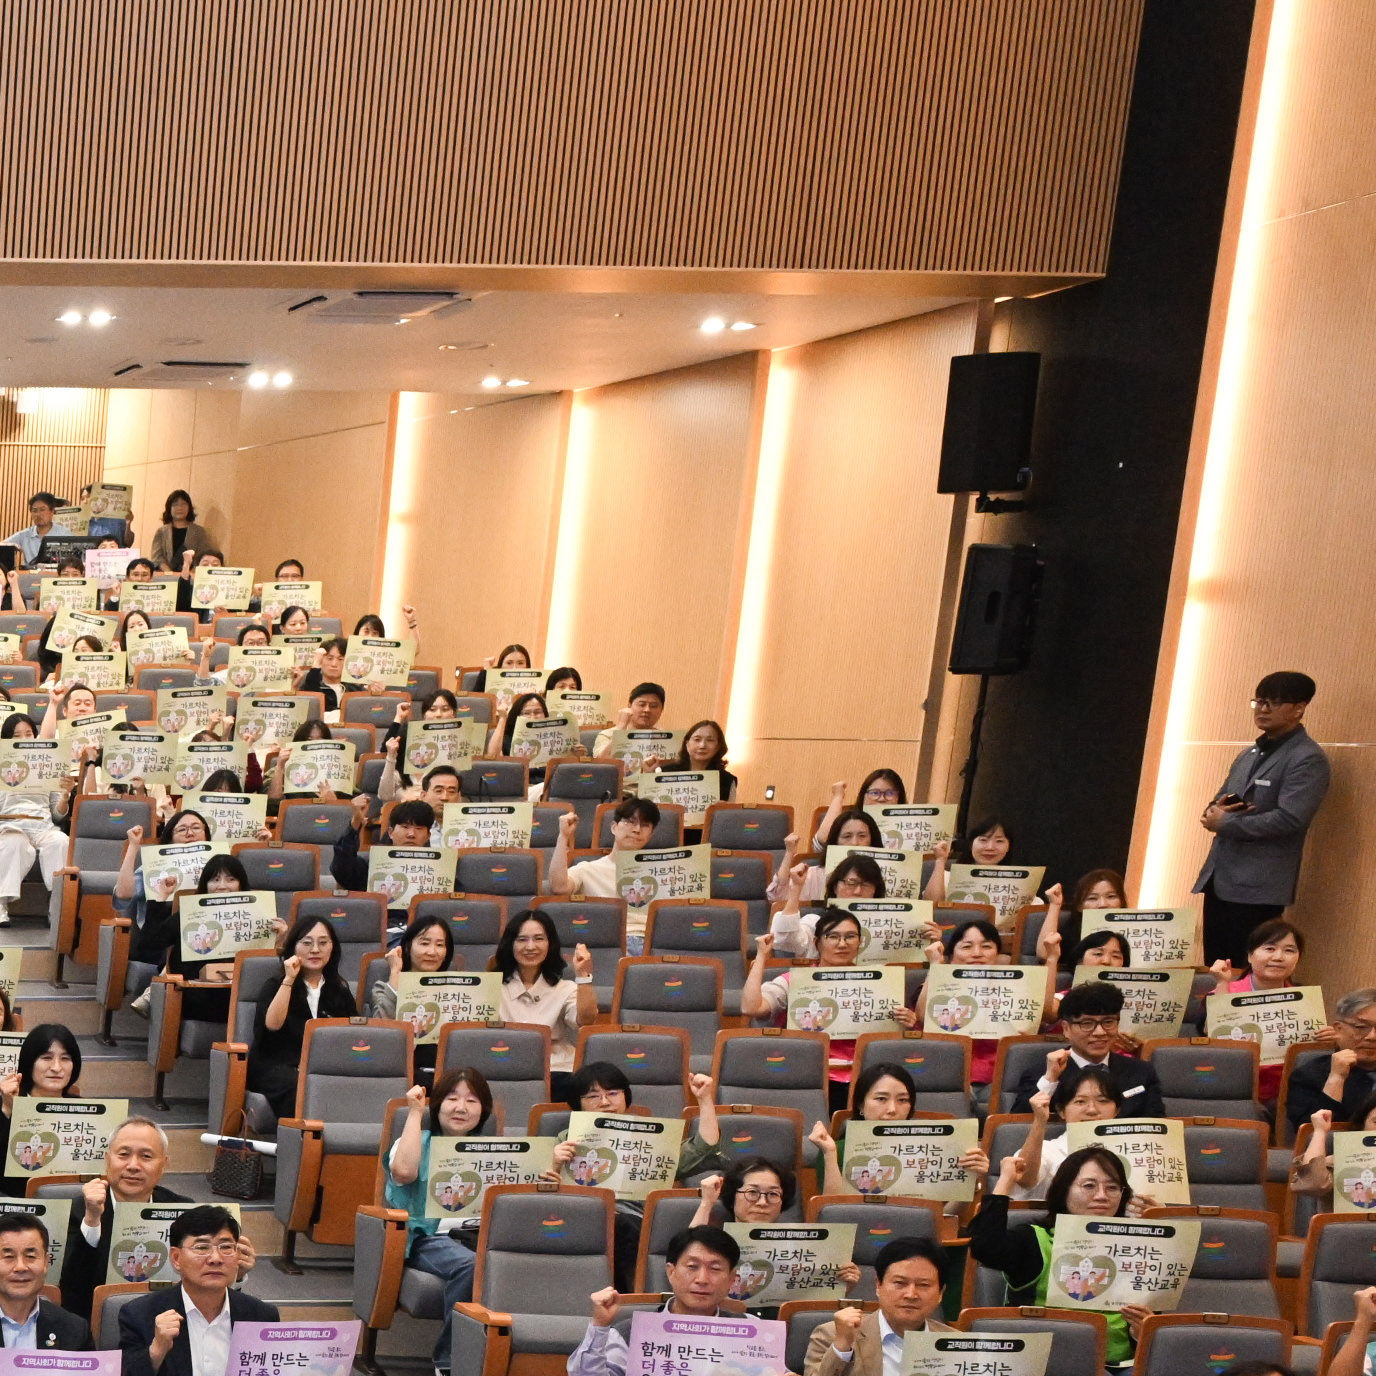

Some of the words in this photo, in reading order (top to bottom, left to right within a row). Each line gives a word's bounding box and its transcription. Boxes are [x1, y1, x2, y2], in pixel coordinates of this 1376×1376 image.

[966, 985, 1013, 997] 가르치는
[979, 997, 1014, 1009] 보람이
[1017, 998, 1041, 1010] 있는
[988, 1010, 1036, 1022] 울산교육
[608, 1137, 653, 1154] 가르치는
[619, 1153, 653, 1168] 보람이
[654, 1155, 675, 1170] 있는
[627, 1166, 669, 1185] 울산교육
[1102, 1243, 1162, 1261] 가르치는
[1118, 1260, 1162, 1276] 보람이
[1166, 1262, 1188, 1277] 있는
[1130, 1276, 1181, 1293] 울산교육
[671, 1322, 710, 1332] 지역사회가
[709, 1324, 748, 1335] 함께합니다
[640, 1340, 672, 1358] 함께
[677, 1345, 724, 1363] 만드는
[641, 1357, 656, 1372] 더
[660, 1359, 692, 1376] 좋은
